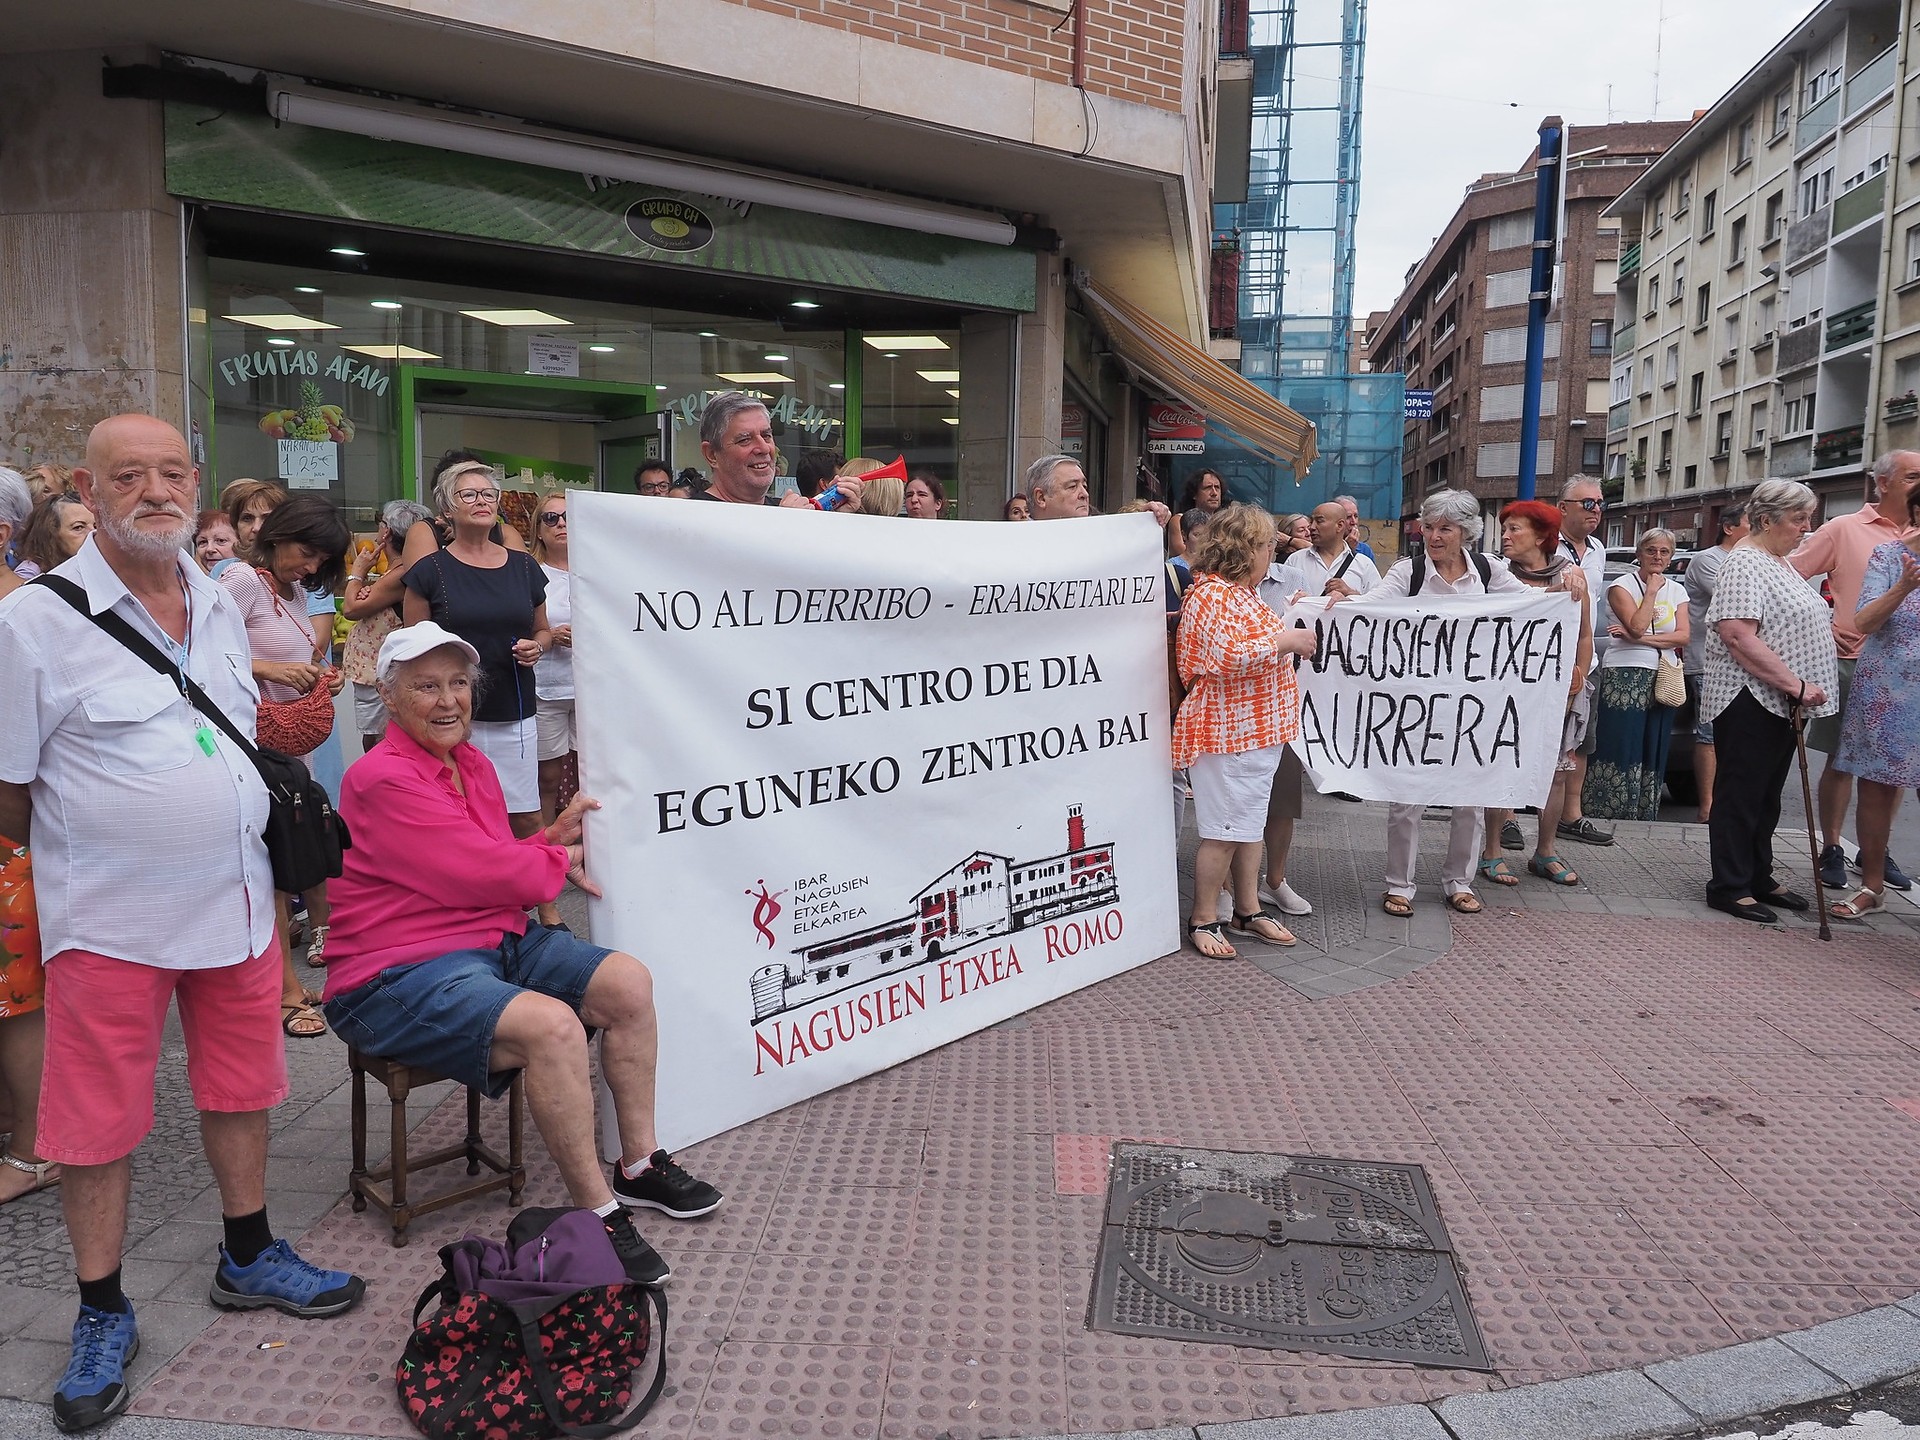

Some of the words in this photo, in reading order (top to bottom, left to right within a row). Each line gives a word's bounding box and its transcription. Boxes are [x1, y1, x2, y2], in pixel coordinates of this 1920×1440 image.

[641, 201, 682, 217] GRUPO
[683, 208, 700, 223] CH
[218, 349, 318, 386] FRUTAS
[324, 355, 389, 397] AFAN
[770, 394, 833, 441] AFAN
[1418, 409, 1432, 418] 720
[280, 440, 325, 454] NARANJA
[1148, 441, 1166, 452] BAR
[1170, 442, 1205, 453] LANDEA
[632, 590, 702, 632] NO
[711, 589, 764, 629] AL
[773, 586, 932, 626] DERRIBO
[967, 577, 1128, 616] ERAISKETARI
[1131, 575, 1156, 604] EZ
[1464, 616, 1563, 683] ETXEA
[746, 686, 793, 729] SI
[805, 666, 973, 721] CENTRO
[982, 660, 1032, 697] DE
[1039, 653, 1103, 690] DIA
[1300, 689, 1521, 769] AURRERA
[653, 756, 901, 834] EGUNEKO
[920, 723, 1089, 784] ZENTROA
[1096, 711, 1149, 749] BAI
[794, 873, 828, 891] IBAR
[794, 875, 869, 906] NAGUSIEN
[793, 906, 868, 935] ELKARTEA
[794, 900, 840, 920] ETXEA
